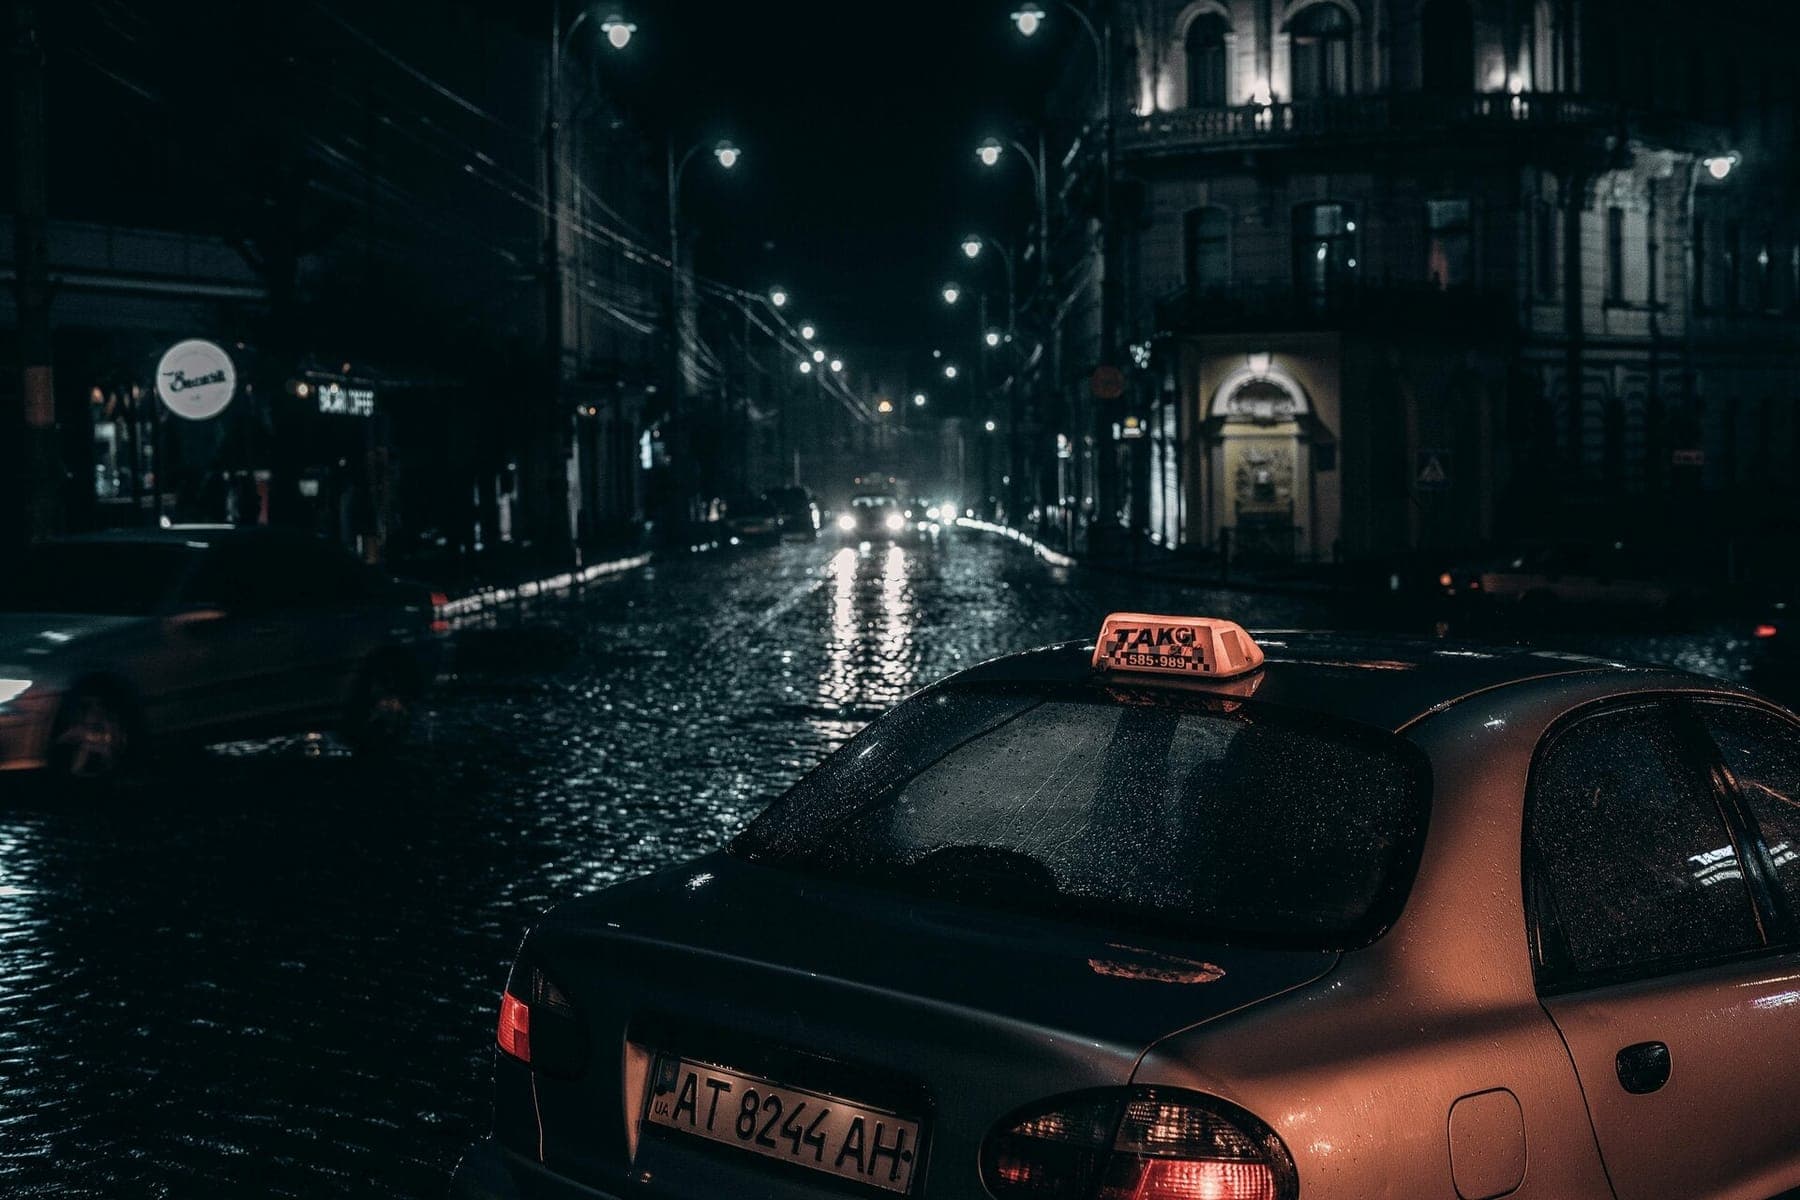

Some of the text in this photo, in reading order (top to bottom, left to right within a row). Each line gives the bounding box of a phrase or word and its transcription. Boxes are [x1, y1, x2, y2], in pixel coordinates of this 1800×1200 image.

[654, 1101, 669, 1117] UA
[674, 1072, 905, 1181] AT 8244 AH
